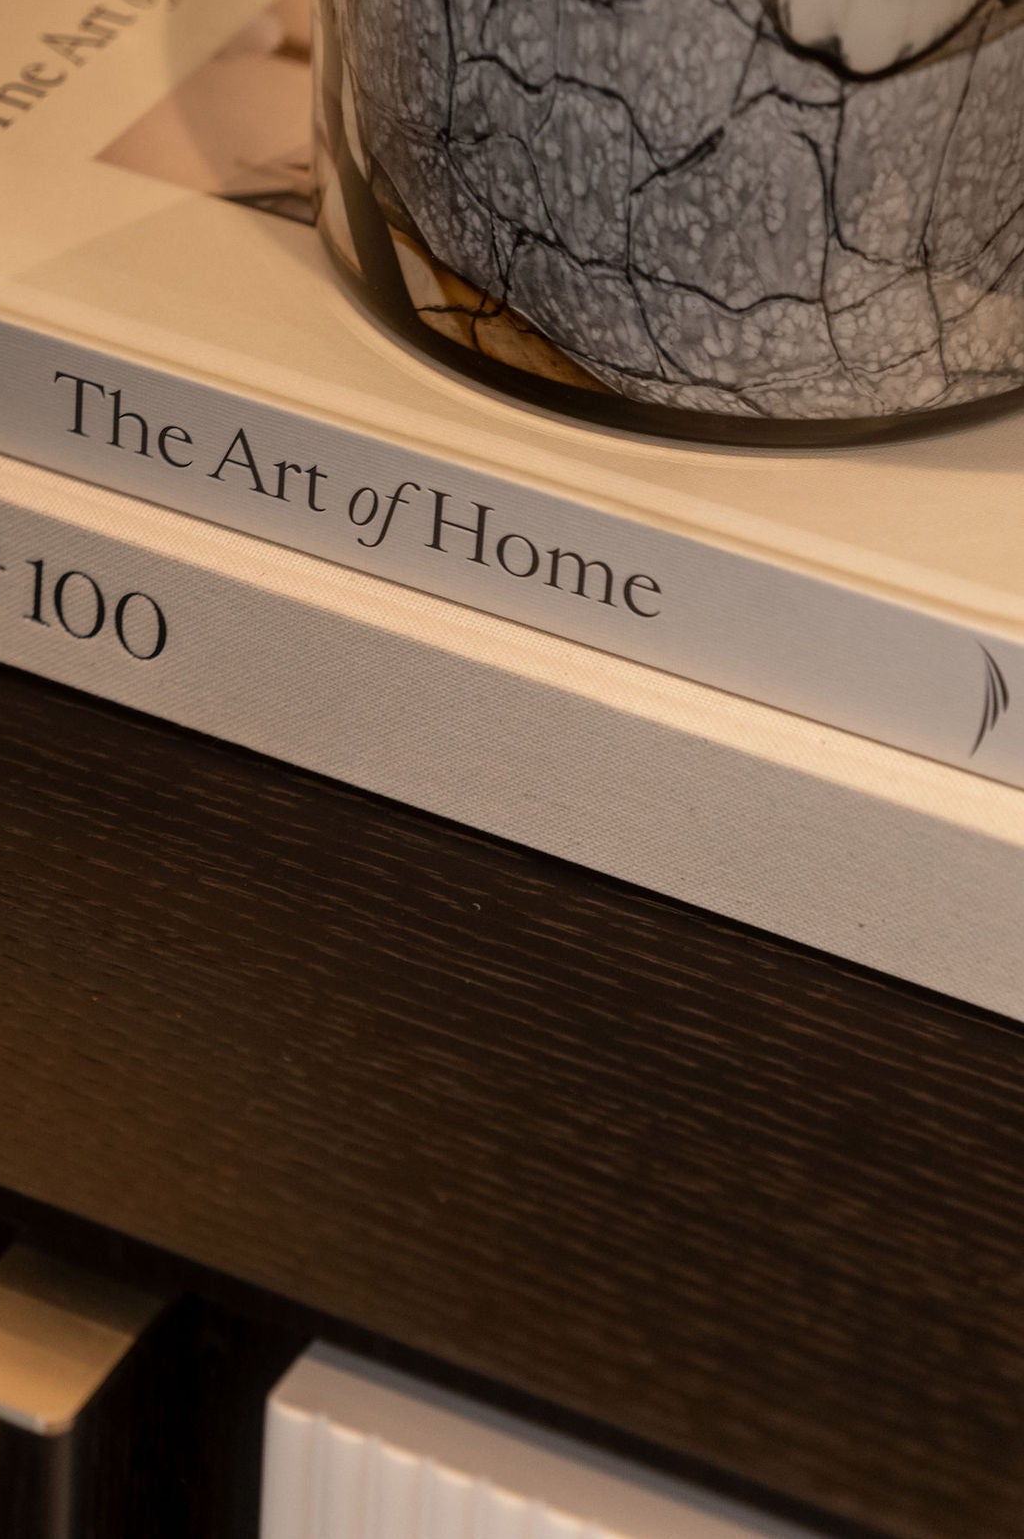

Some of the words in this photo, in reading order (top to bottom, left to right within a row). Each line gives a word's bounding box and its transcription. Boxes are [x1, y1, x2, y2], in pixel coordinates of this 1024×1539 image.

[42, 4, 136, 67] Art
[54, 371, 193, 468] The
[207, 428, 328, 513] Art
[348, 482, 420, 547] of
[424, 488, 662, 618] Home
[23, 559, 167, 661] 100
